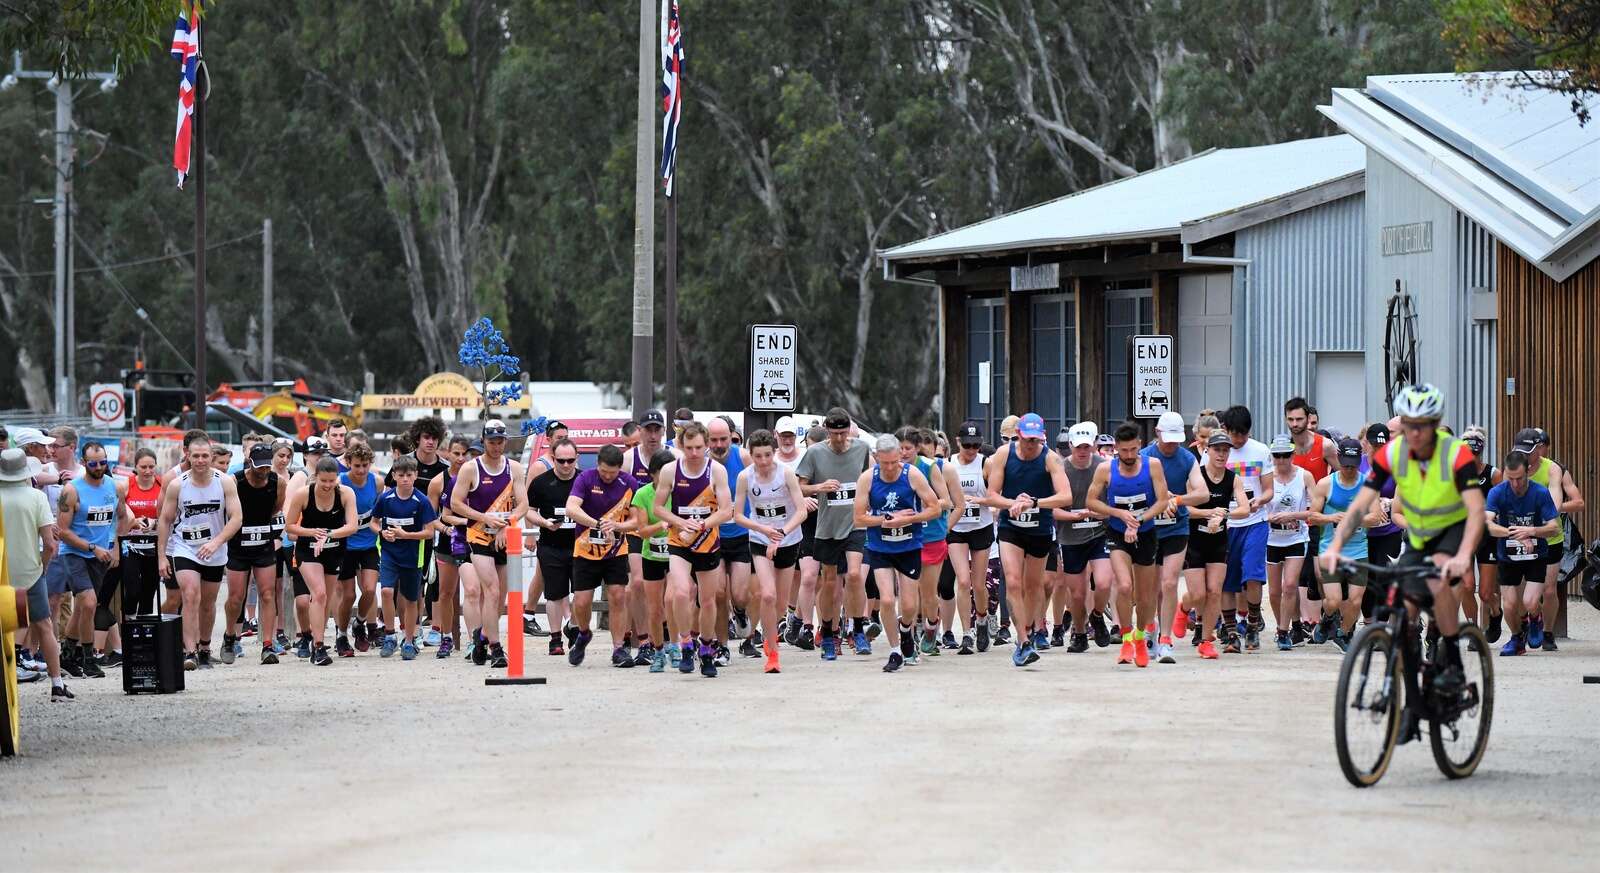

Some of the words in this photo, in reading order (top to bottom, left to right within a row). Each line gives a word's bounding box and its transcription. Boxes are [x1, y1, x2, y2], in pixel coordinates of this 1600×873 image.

[757, 335, 792, 349] END
[1138, 345, 1168, 358] END
[758, 357, 790, 365] SHARED
[763, 370, 784, 378] ZONE
[1139, 366, 1168, 374] SHARED
[1144, 378, 1162, 386] ZONE
[97, 399, 119, 413] 40
[383, 397, 471, 407] PADDLEWHEEL
[567, 429, 616, 438] ERITAGE
[836, 490, 848, 499] 39
[1128, 503, 1134, 511] 2
[94, 513, 108, 521] 109
[891, 528, 904, 536] 93
[657, 544, 669, 553] 12
